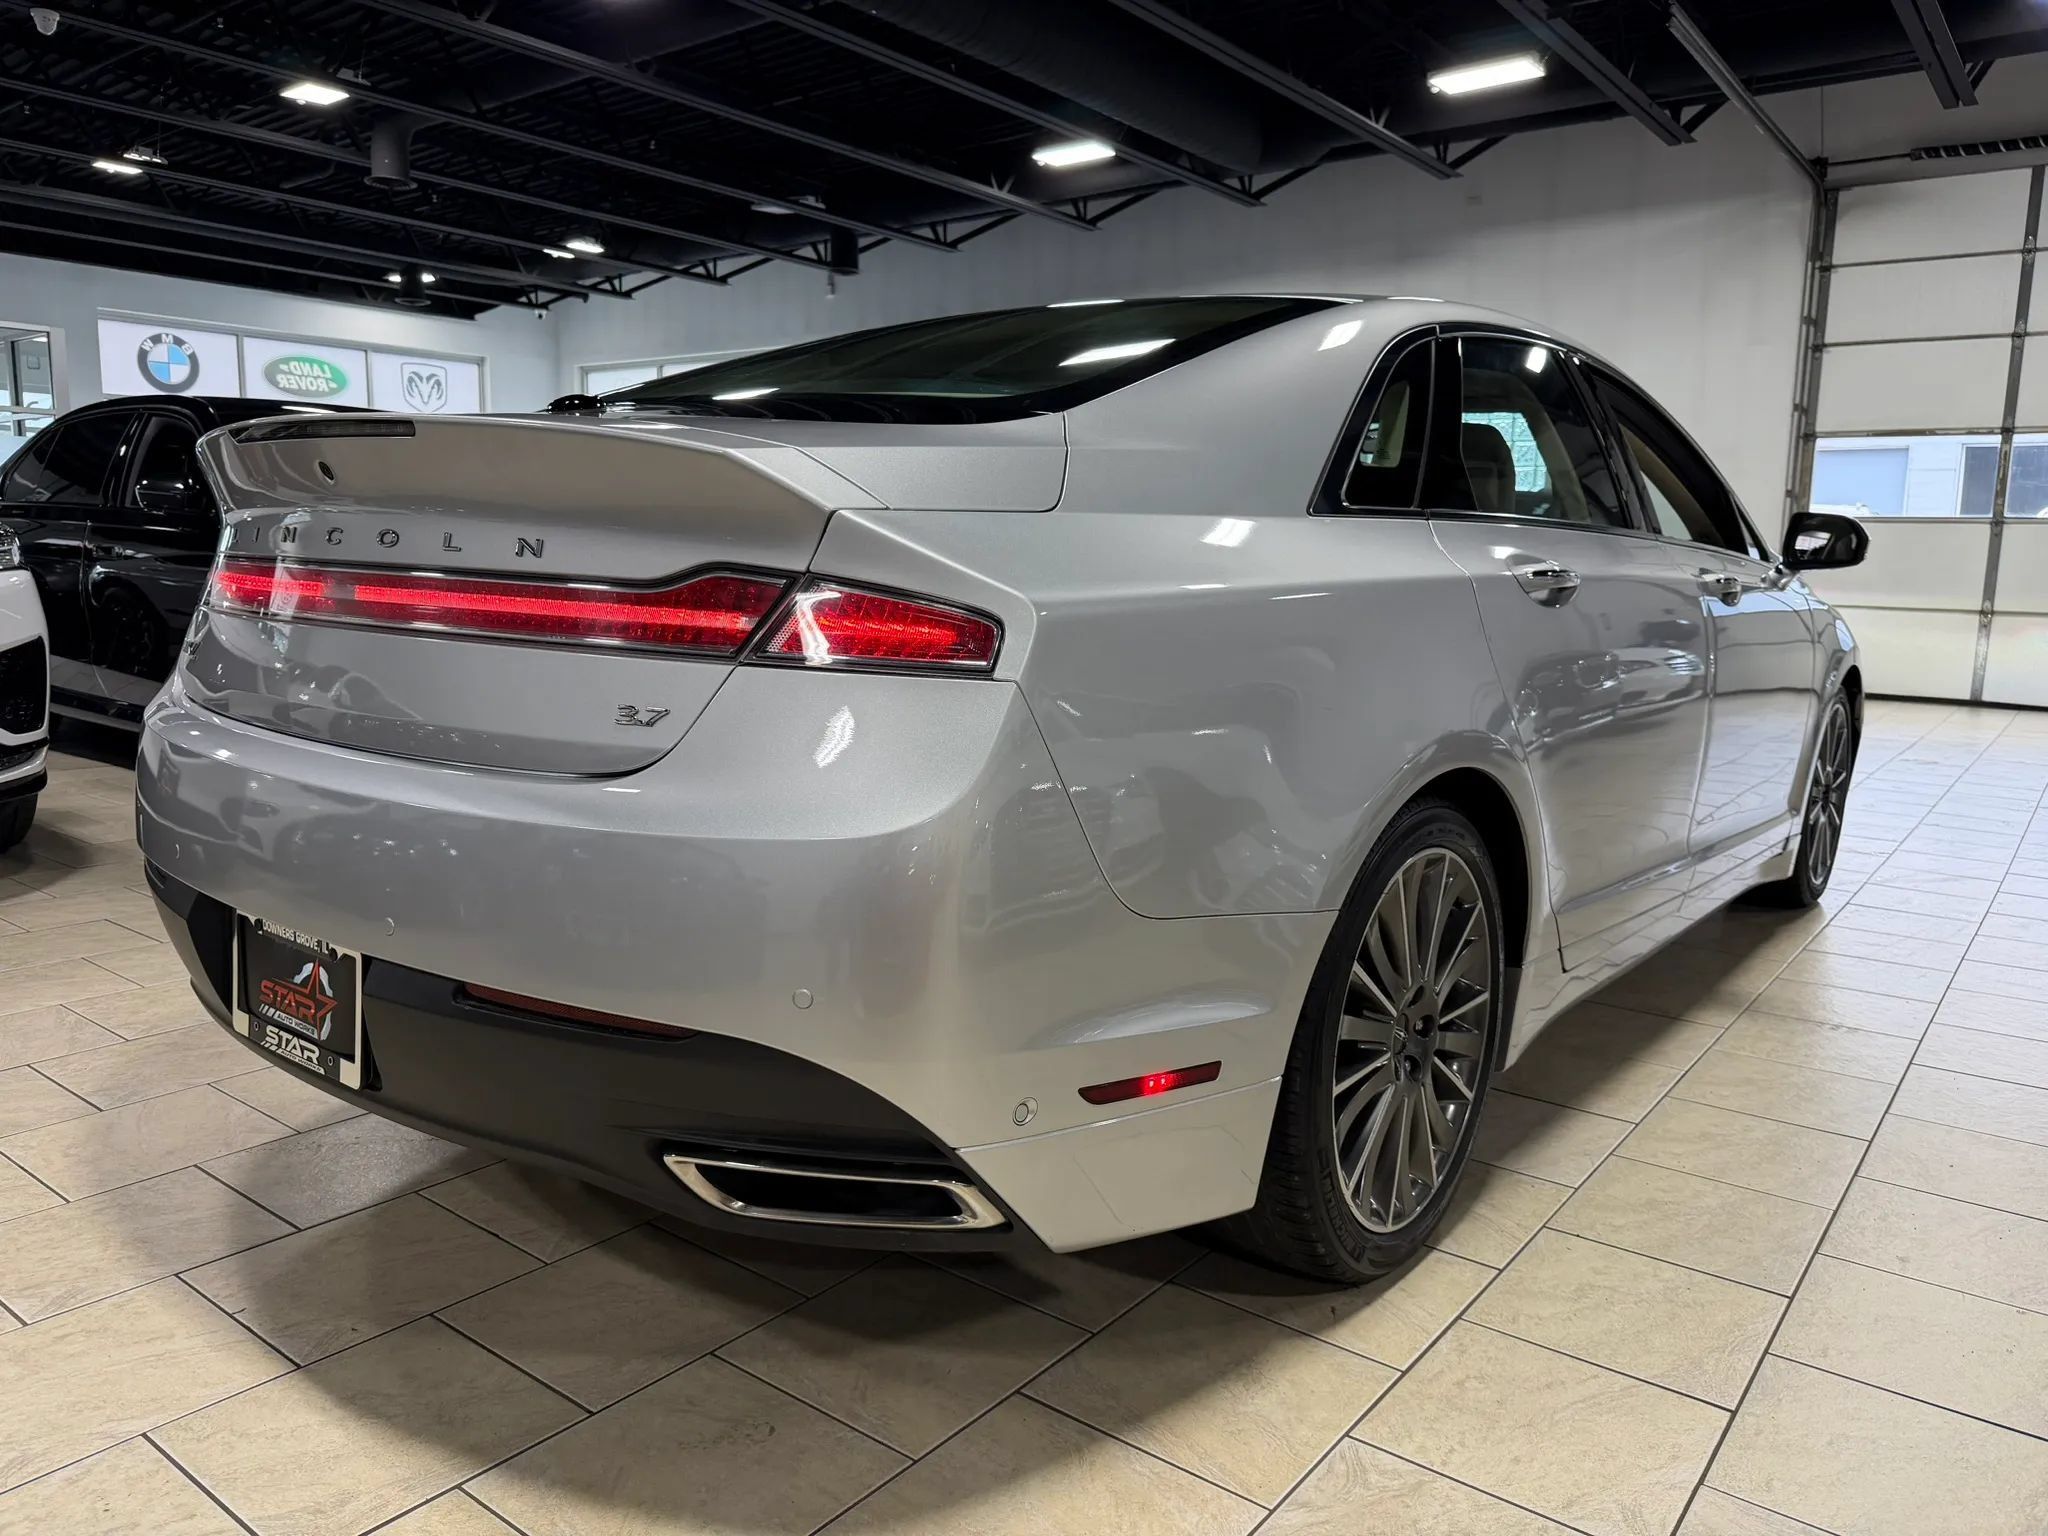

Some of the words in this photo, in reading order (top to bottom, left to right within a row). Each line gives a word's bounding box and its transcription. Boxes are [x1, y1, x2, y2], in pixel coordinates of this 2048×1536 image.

[262, 918, 295, 942] DOWNERS
[259, 979, 316, 1025] STAR
[276, 1012, 294, 1026] AUTO
[265, 1024, 320, 1065] STAR
